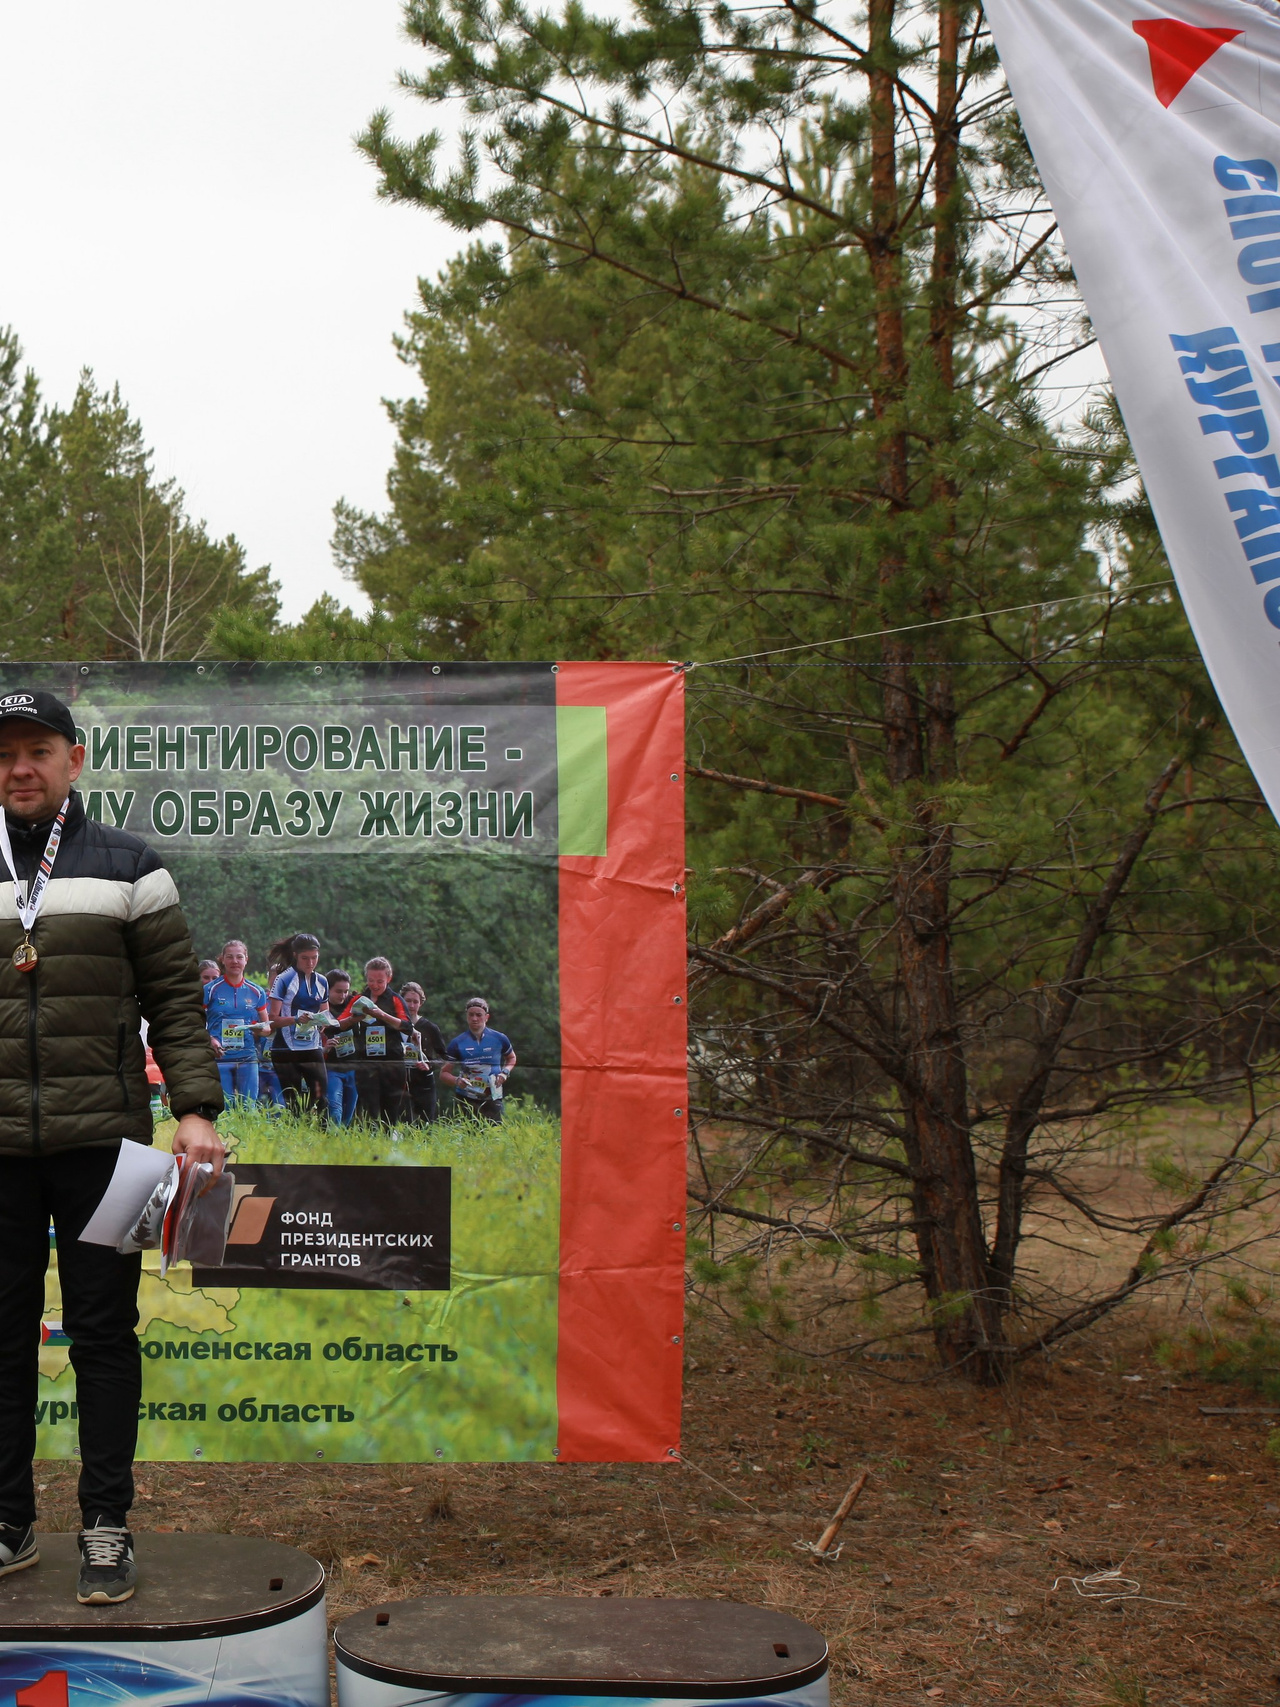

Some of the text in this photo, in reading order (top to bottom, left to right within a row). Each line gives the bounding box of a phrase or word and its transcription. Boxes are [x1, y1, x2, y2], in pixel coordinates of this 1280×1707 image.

[3, 695, 28, 706] KIA
[5, 706, 38, 714] MOTORS
[75, 724, 487, 773] ИЕНТИРОВАНИЕ
[151, 789, 342, 838] ОБРАЗУ
[359, 790, 534, 838] ЖИЗНИ
[280, 1211, 333, 1227] ФОНД
[280, 1232, 434, 1248] ПРЕЗИДЕНТСКИХ
[280, 1253, 361, 1267] ГРАНТОВ
[138, 1336, 458, 1362] юменская область
[217, 1397, 354, 1423] область
